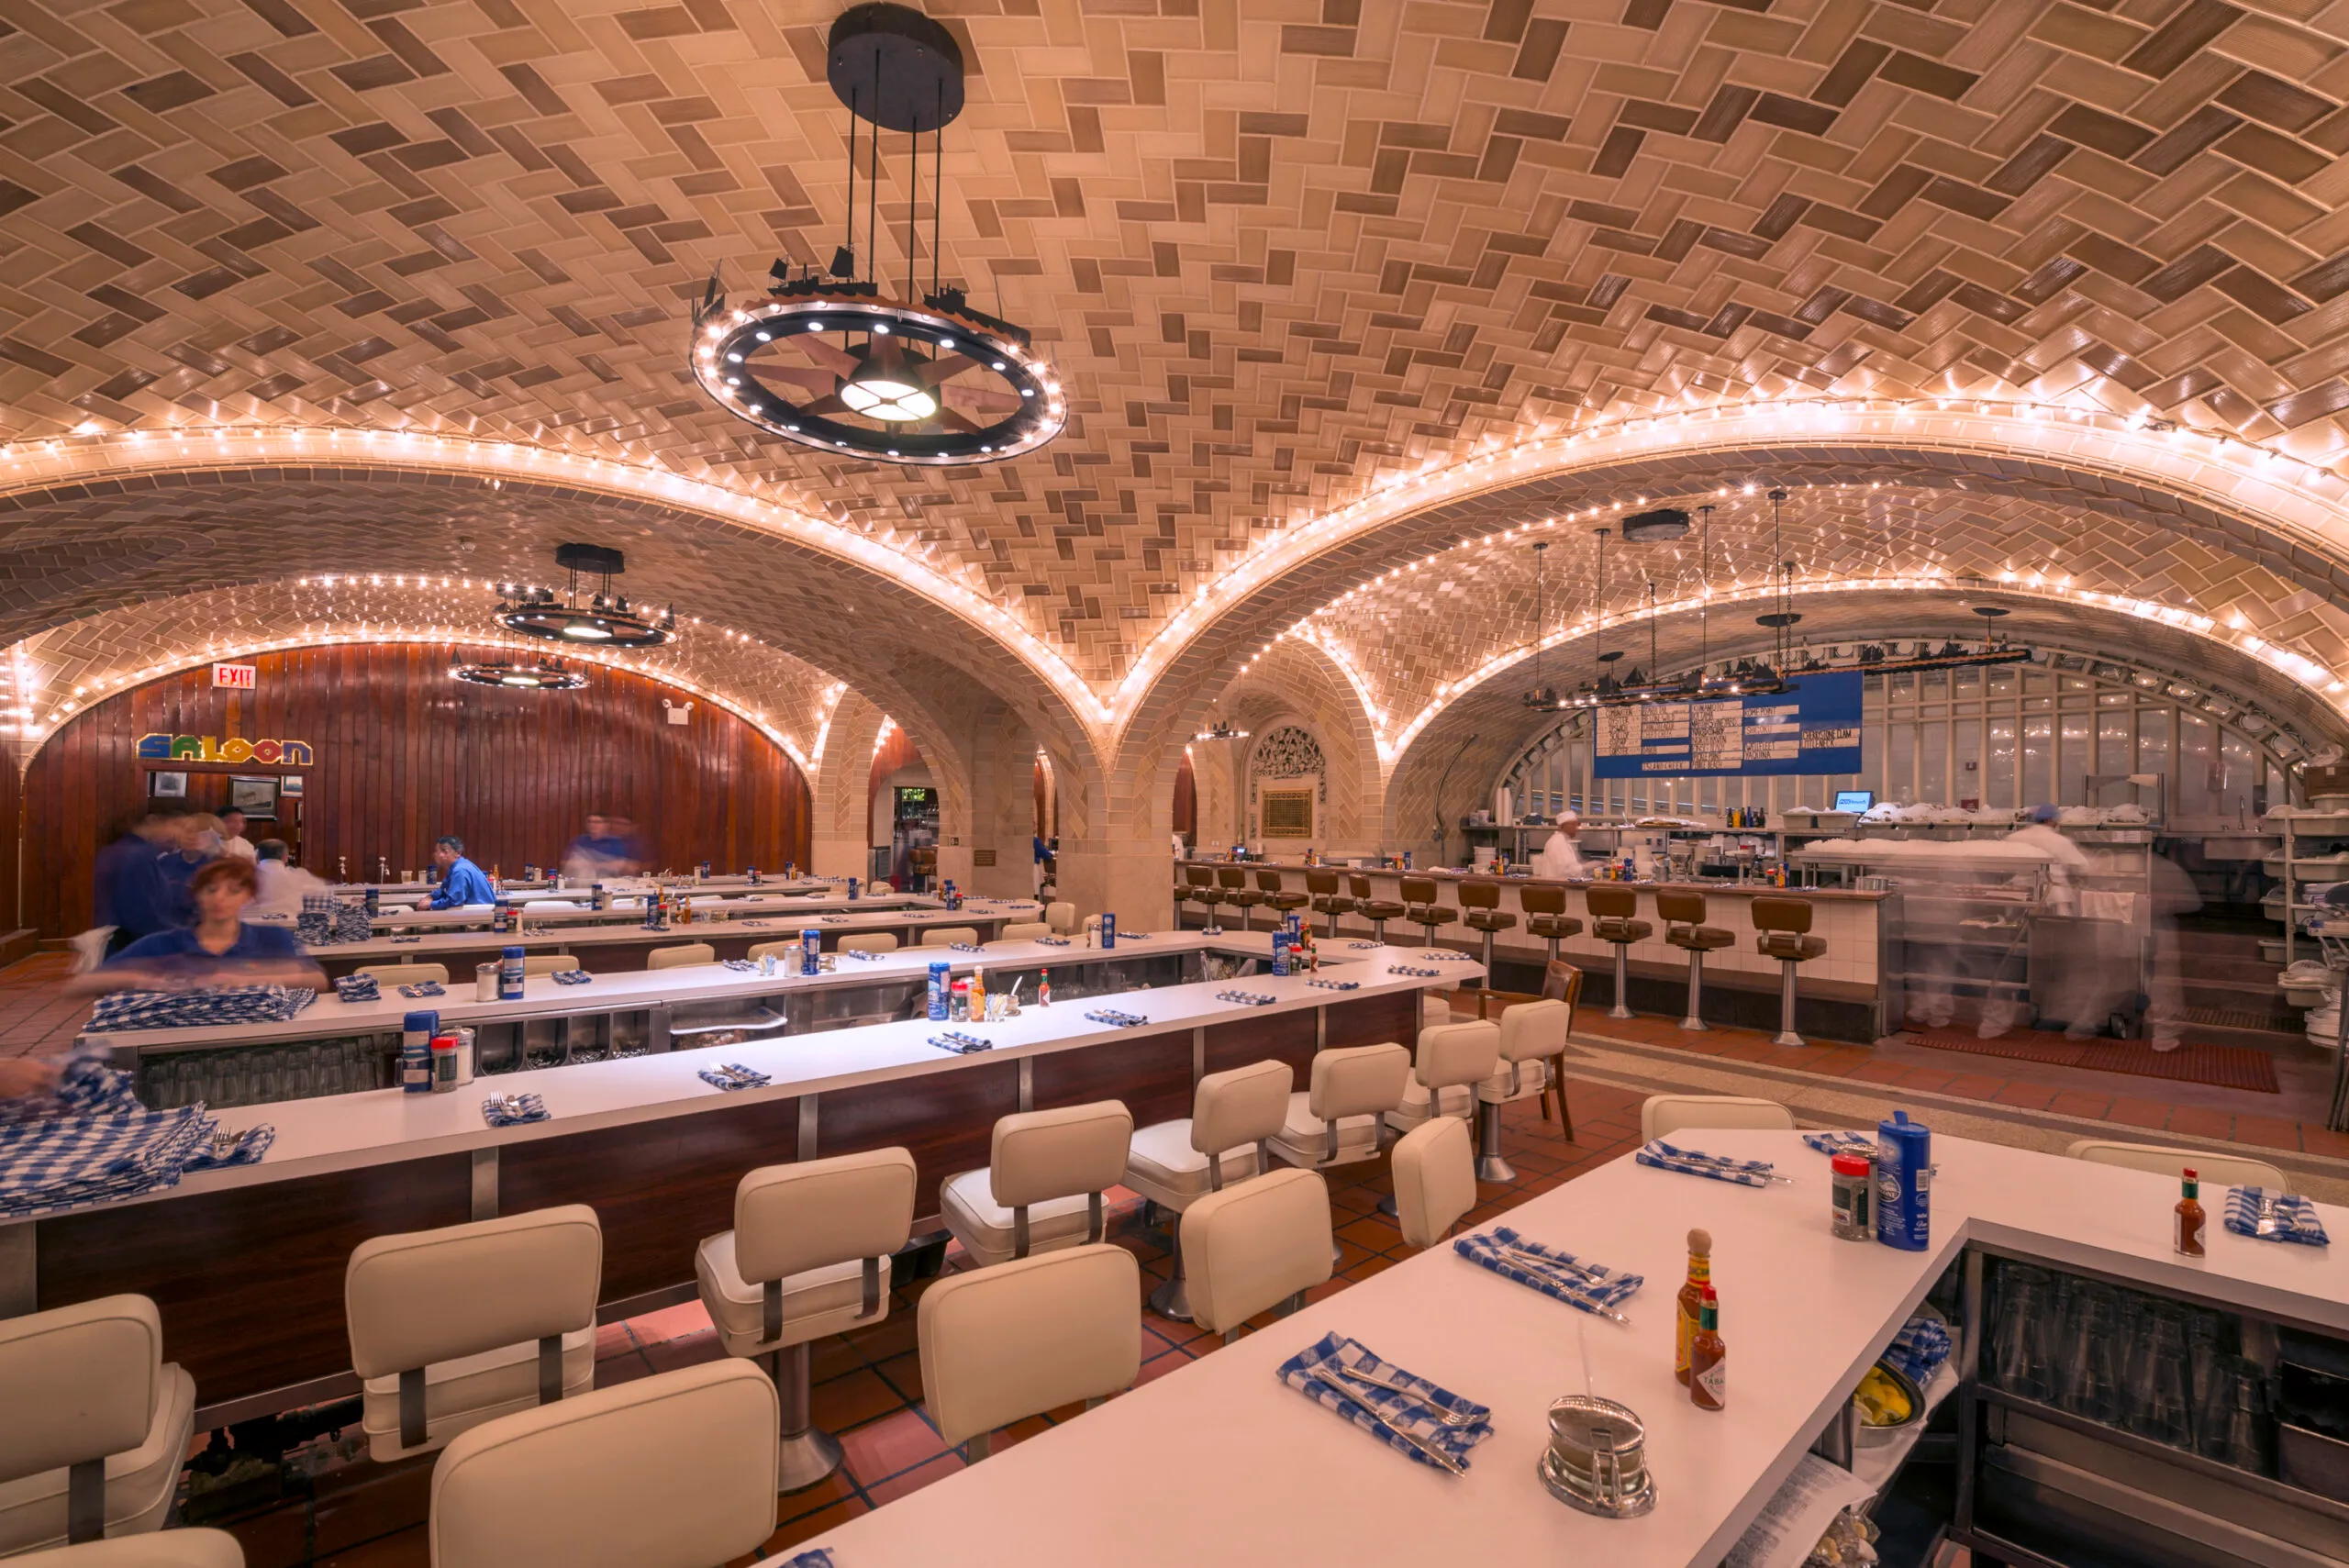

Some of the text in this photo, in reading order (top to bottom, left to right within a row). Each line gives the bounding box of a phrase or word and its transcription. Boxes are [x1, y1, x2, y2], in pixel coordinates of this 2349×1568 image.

[219, 667, 253, 688] EXIT
[1837, 728, 1852, 739] CLAM
[1802, 739, 1835, 750] LITTLENECK
